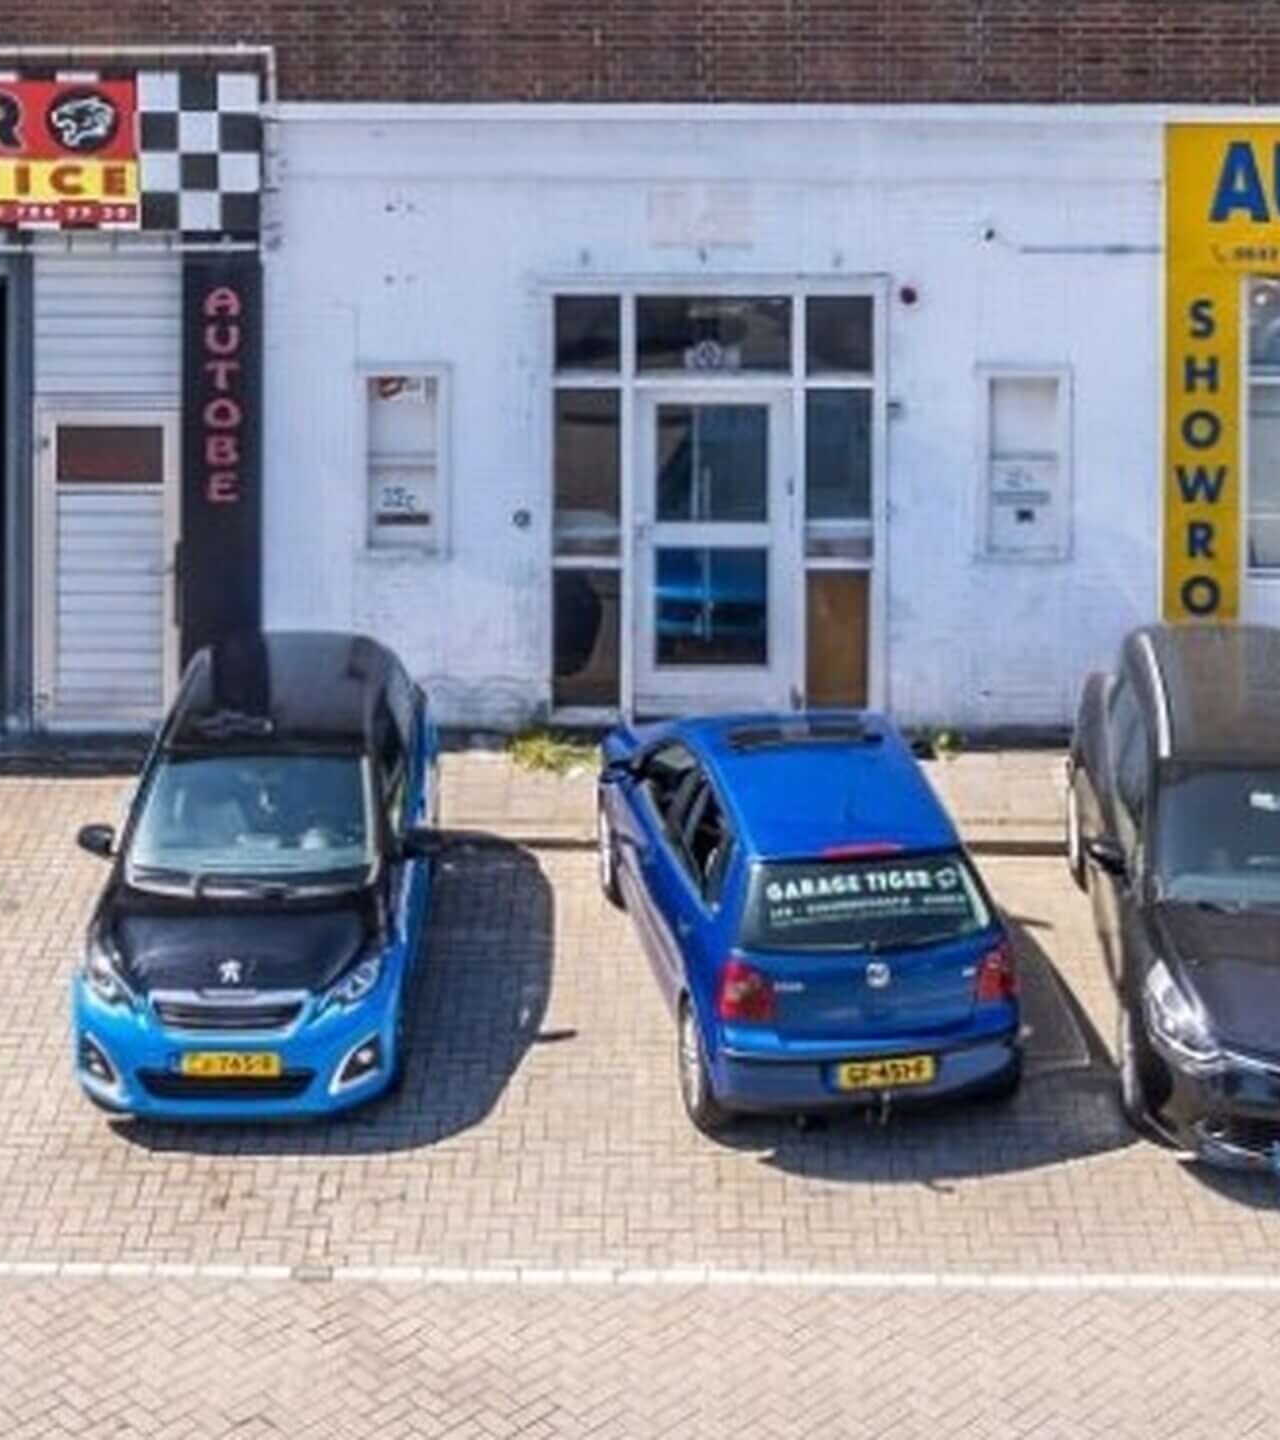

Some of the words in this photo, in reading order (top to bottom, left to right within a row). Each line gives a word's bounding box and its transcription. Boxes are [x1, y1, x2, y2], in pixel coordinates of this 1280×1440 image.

[203, 287, 242, 502] AUTOBE
[1175, 298, 1227, 616] SHOWRO
[765, 874, 861, 902] GARAGE
[865, 869, 932, 892] TIGER
